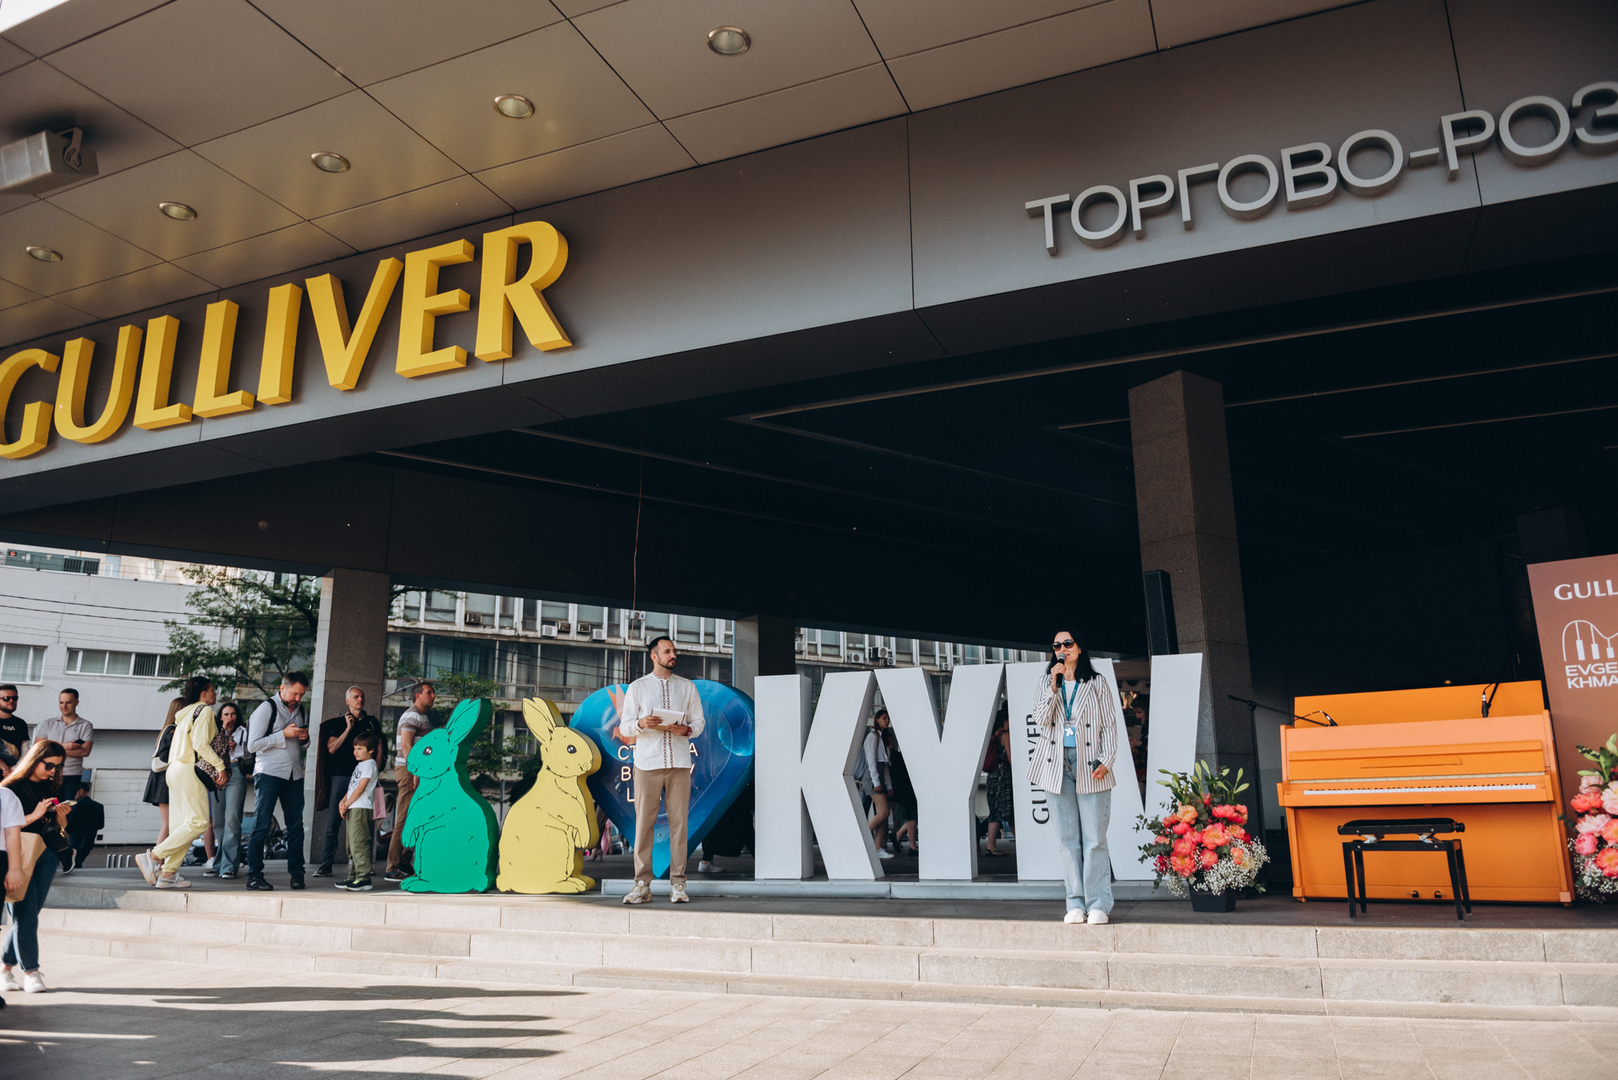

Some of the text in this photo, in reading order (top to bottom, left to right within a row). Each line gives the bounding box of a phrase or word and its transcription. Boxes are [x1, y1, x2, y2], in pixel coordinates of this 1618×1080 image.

[1025, 81, 1618, 257] ТОРГОВО-РОЗ
[0, 220, 574, 460] GULLIVER
[1554, 579, 1618, 600] GULL
[1565, 662, 1618, 677] EVGE
